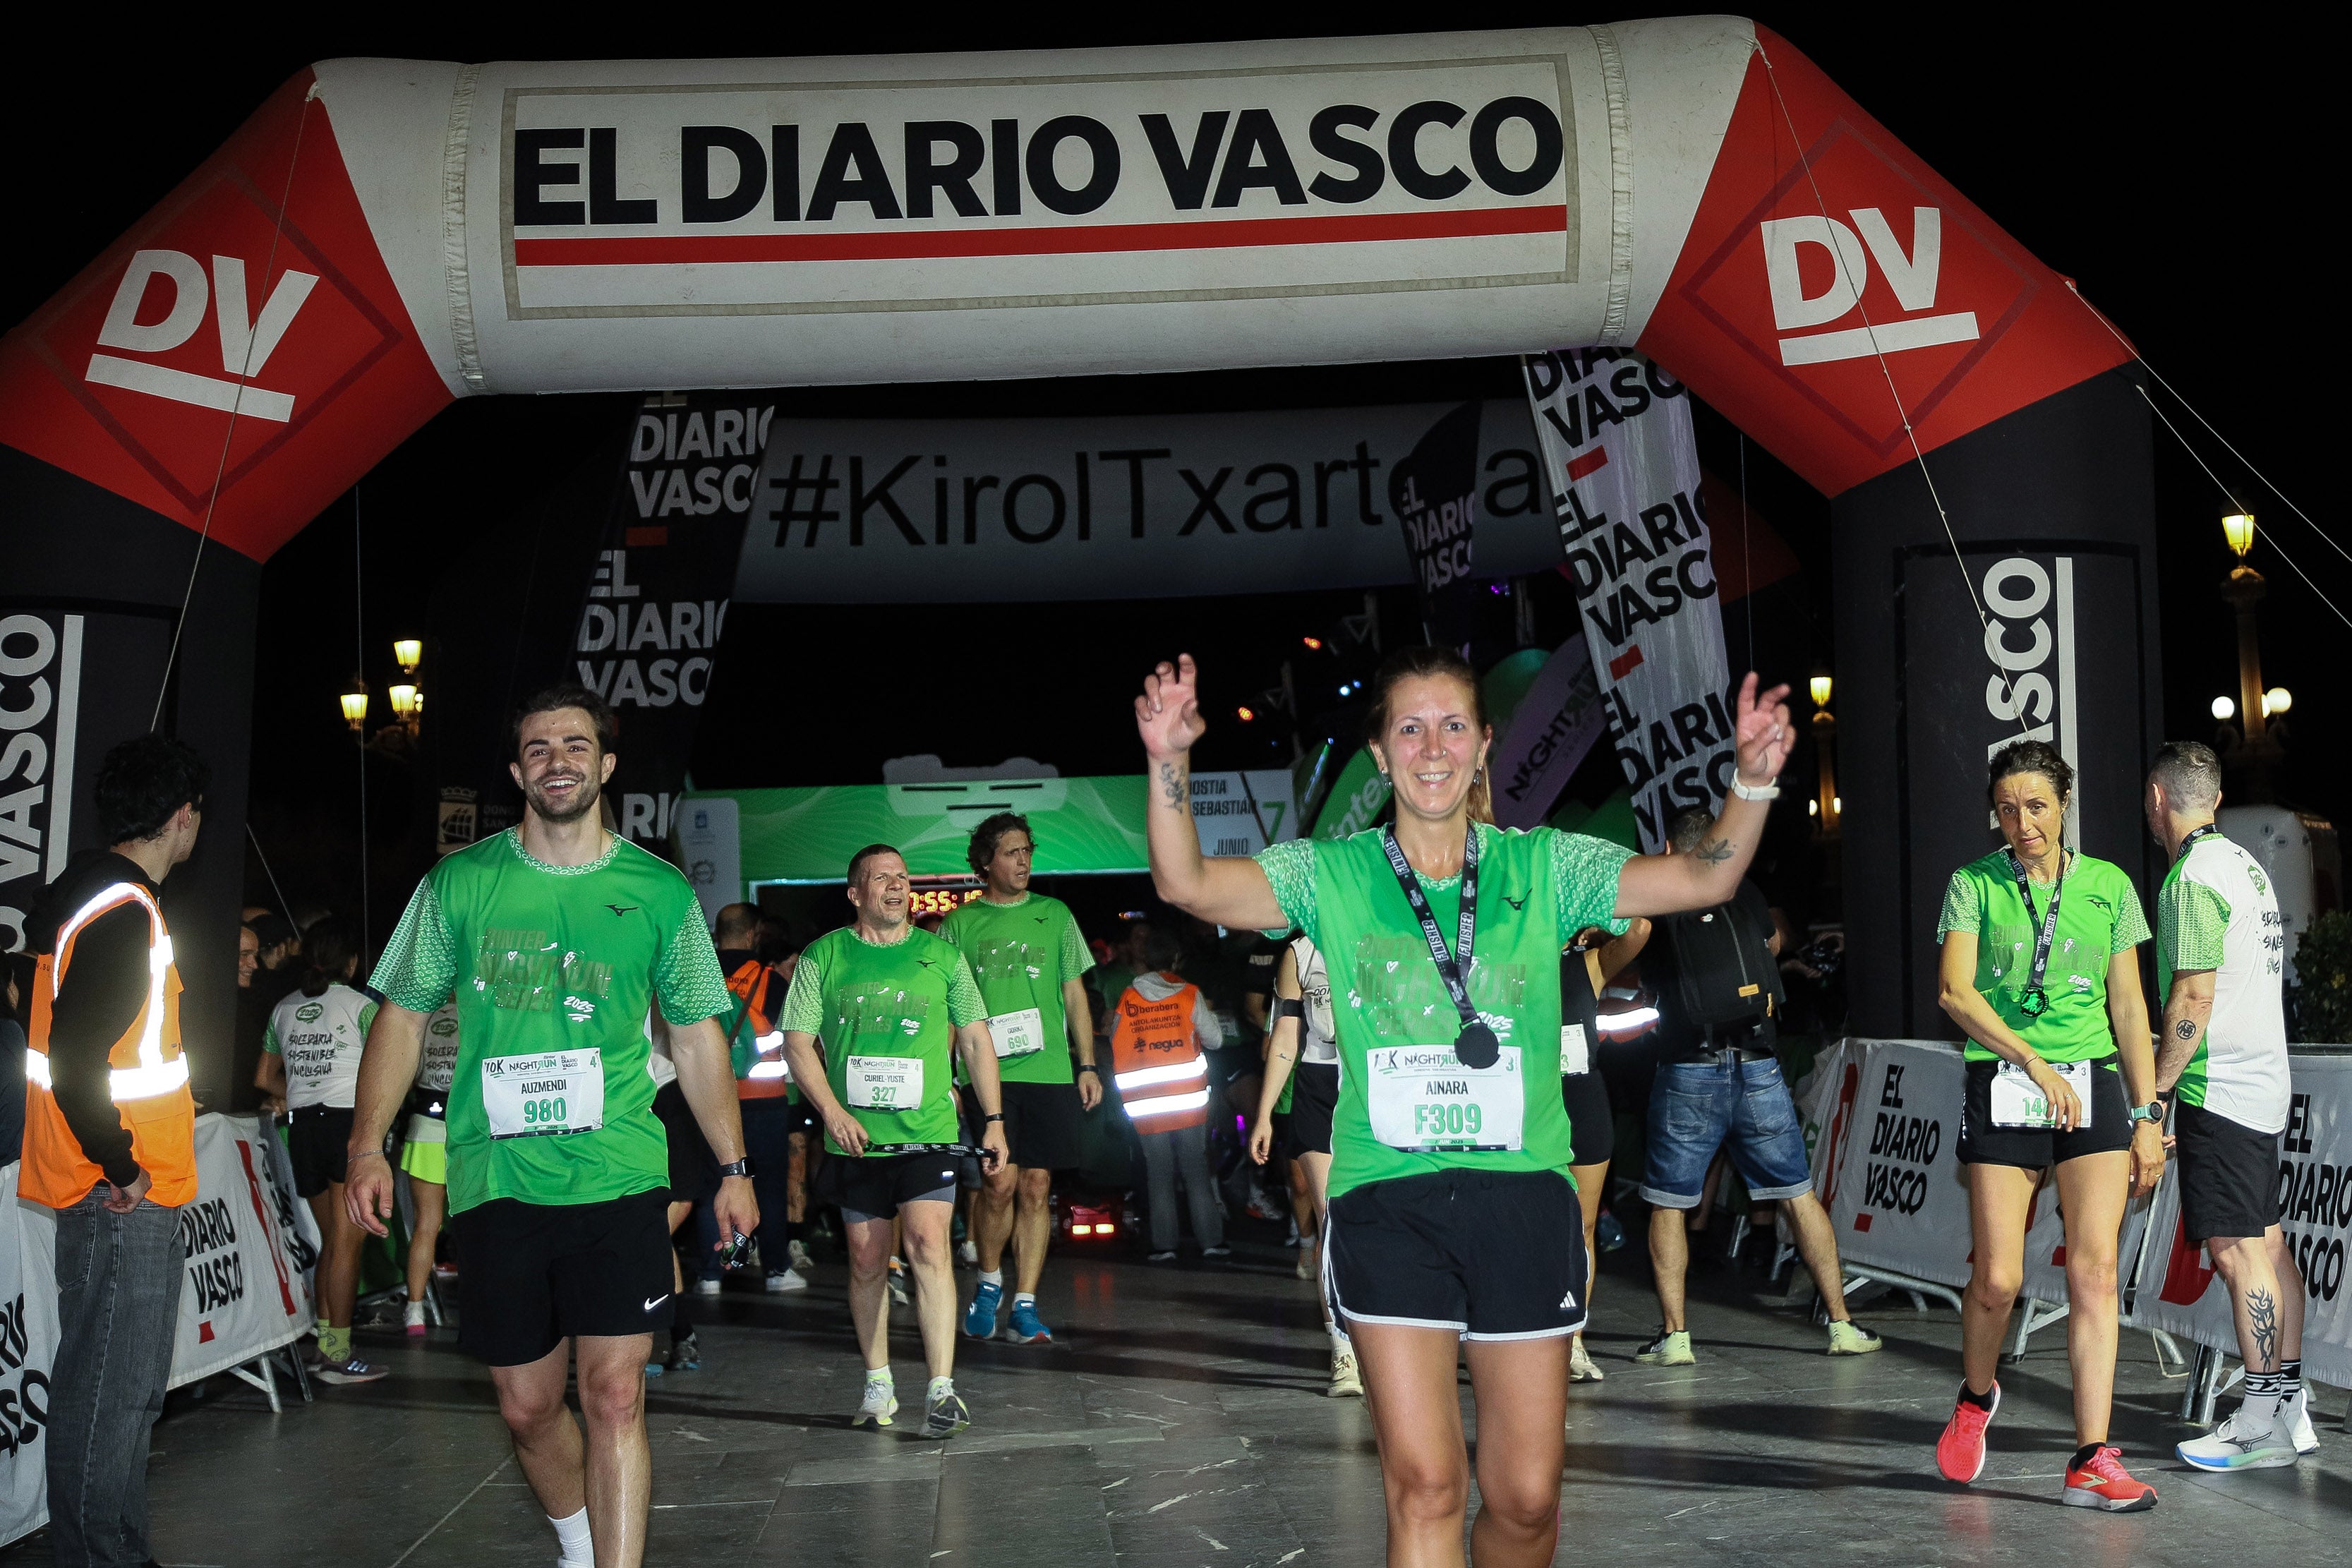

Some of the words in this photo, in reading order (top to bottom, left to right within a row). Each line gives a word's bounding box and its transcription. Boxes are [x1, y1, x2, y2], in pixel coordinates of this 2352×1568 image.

[514, 128, 657, 226] EL
[682, 115, 1121, 223] DIARIO
[1138, 96, 1563, 211] VASCO
[1761, 207, 1941, 330] DV
[97, 250, 320, 378] DV
[629, 464, 759, 519] VASC
[1555, 487, 1607, 545] EL
[589, 550, 640, 598] EL
[1585, 549, 1717, 647] VASC
[577, 658, 715, 707] VASC
[1262, 801, 1286, 844] 7
[1214, 838, 1248, 856] JUNIO
[1422, 919, 1449, 962] FINISHER
[1457, 912, 1473, 957] FINISHER
[2043, 913, 2056, 946] FINISHER
[2068, 975, 2092, 987] 2025
[564, 996, 595, 1013] 2025
[1140, 1003, 1179, 1014] berabera
[900, 1018, 920, 1028] 2025
[1007, 1025, 1024, 1034] GORKA
[1129, 1015, 1181, 1027] ANTOLAKUNTZA
[287, 1049, 336, 1061] SOSTENIBLE
[1007, 1034, 1030, 1049] 690
[1149, 1039, 1183, 1052] negua
[485, 1059, 505, 1075] 10K
[590, 1056, 597, 1068] 4
[850, 1058, 862, 1068] 10K
[1374, 1049, 1399, 1070] 1K
[1506, 1057, 1514, 1072] 3
[2081, 1067, 2087, 1076] 3
[521, 1079, 567, 1094] AUZMENDI
[872, 1086, 897, 1102] 327
[1425, 1080, 1469, 1095] AINARA
[1881, 1064, 1905, 1109] EL
[524, 1097, 567, 1123] 980
[1414, 1103, 1482, 1134] F309
[2284, 1094, 2312, 1154] EL
[1869, 1111, 1940, 1165] DIARIO
[1864, 1162, 1927, 1216] VASCO
[2279, 1159, 2352, 1229] DIARIO
[188, 1251, 243, 1314] VASCO
